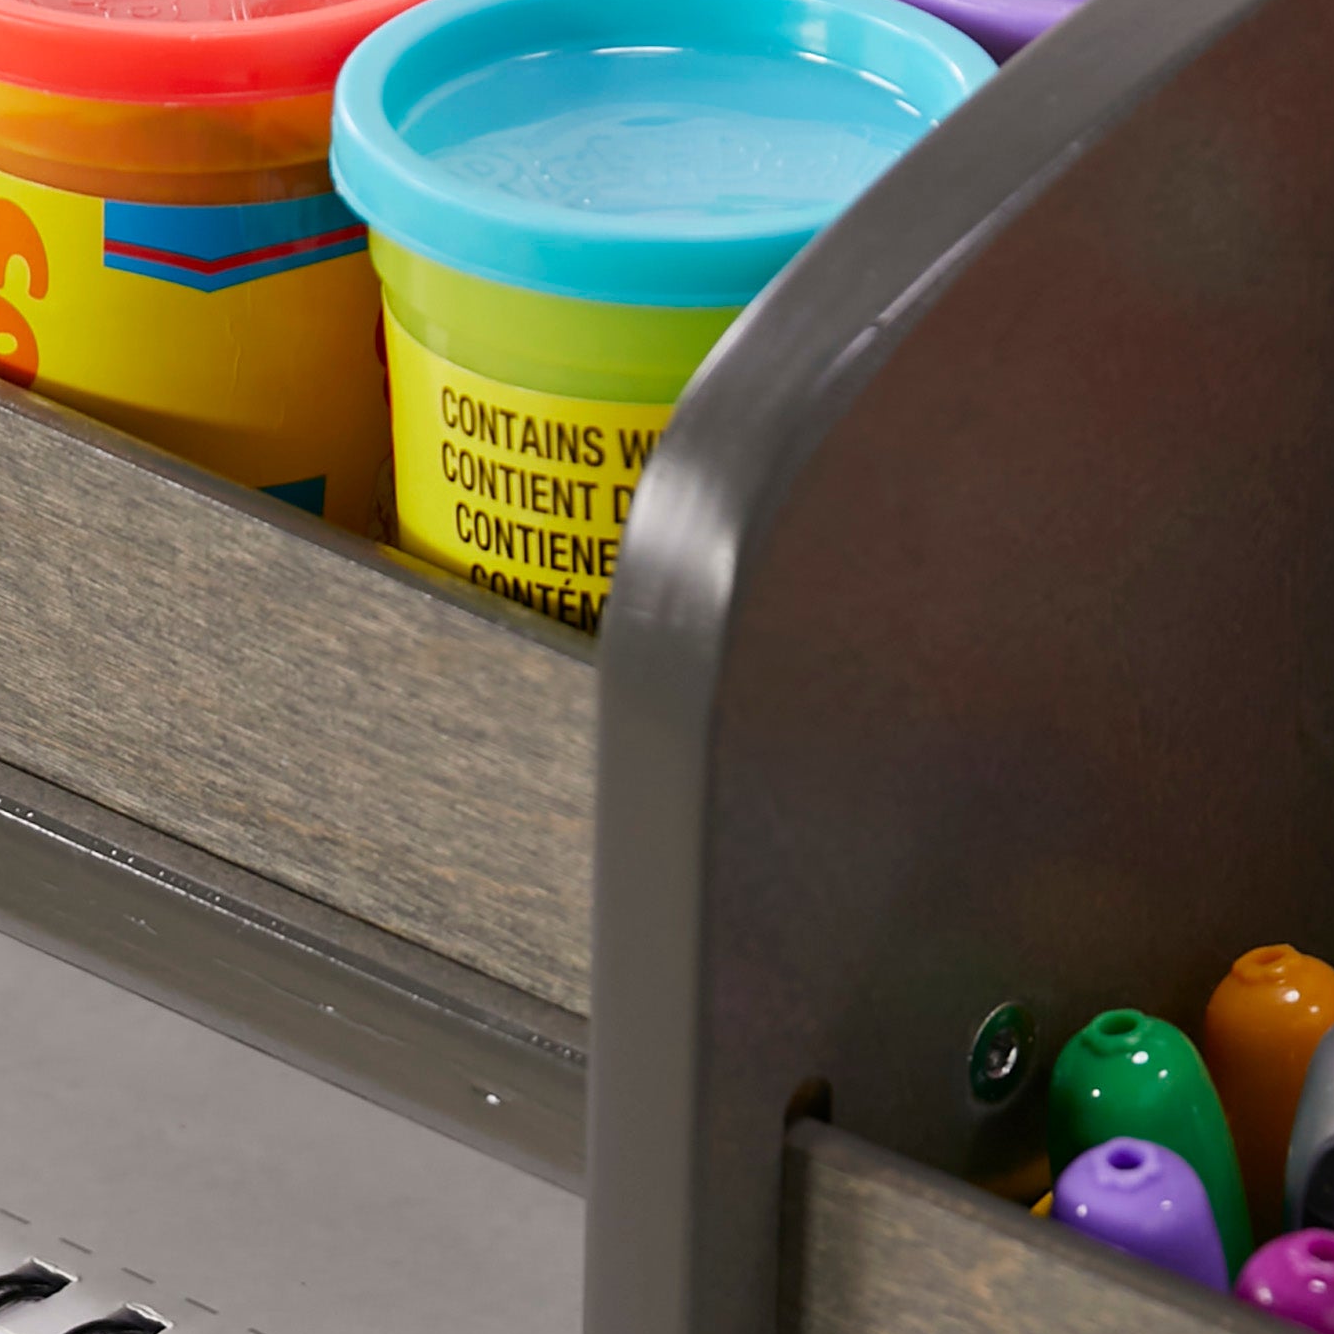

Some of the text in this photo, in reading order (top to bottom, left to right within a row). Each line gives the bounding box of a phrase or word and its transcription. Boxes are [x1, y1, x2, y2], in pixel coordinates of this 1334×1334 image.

[441, 385, 605, 468] CONTAINS
[441, 440, 599, 522] CONTIENT
[455, 501, 619, 578] CONTIENE
